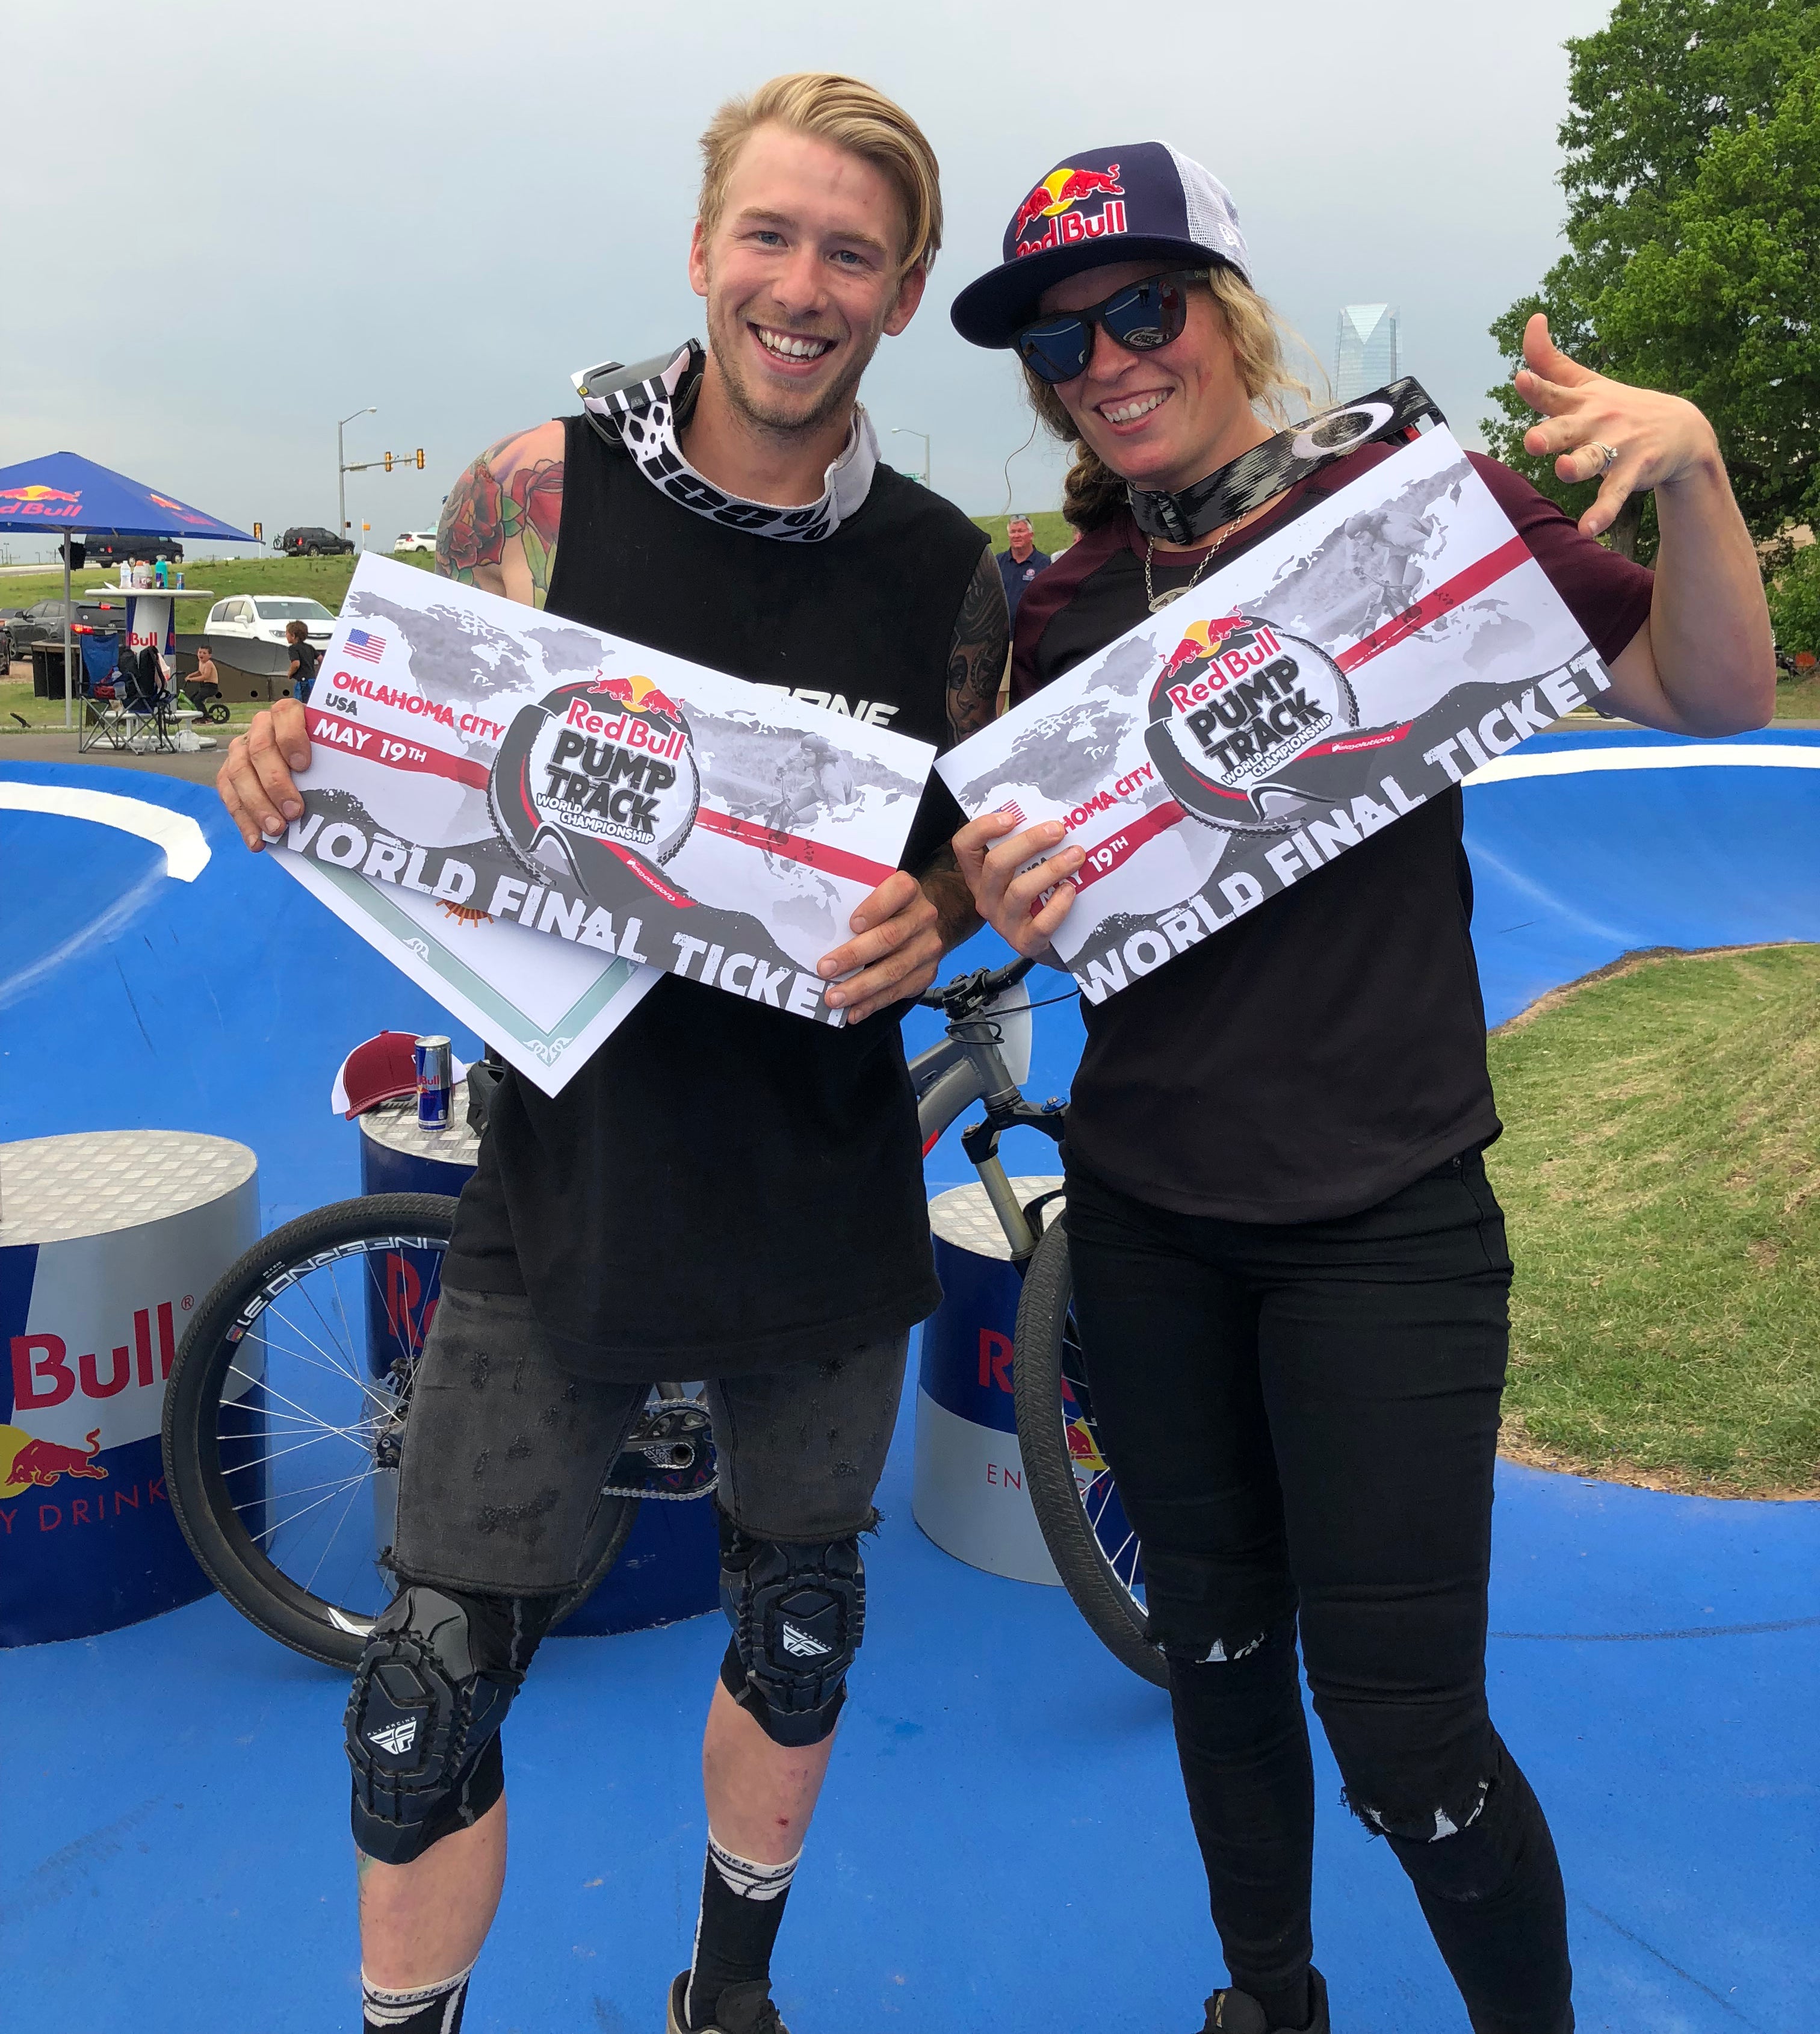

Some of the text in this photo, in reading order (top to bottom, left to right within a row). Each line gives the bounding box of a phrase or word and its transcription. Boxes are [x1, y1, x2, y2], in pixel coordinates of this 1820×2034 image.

[1060, 200, 1127, 244] Bull
[21, 501, 83, 517] Bull
[131, 631, 158, 646] Bull
[1169, 627, 1281, 713] Red Bull
[326, 693, 358, 716] USA
[333, 671, 506, 742] OKLAHOMA CITY
[1186, 654, 1299, 747] PUMP
[314, 718, 427, 763] MAY 19TH
[566, 698, 686, 761] Red Bull
[1202, 687, 1322, 771] TRACK
[1252, 713, 1333, 777] CHAMPIONSHIP
[552, 729, 676, 795] PUMP
[1221, 752, 1264, 786] WORLD
[536, 793, 583, 815] WORLD
[545, 764, 660, 834] TRACK
[1062, 761, 1154, 835] HOMA CITY
[560, 812, 655, 844] CHAMPIONSHIP
[1074, 648, 1612, 1006] WORLD FINAL TICKET
[1088, 836, 1129, 873] 19TH
[488, 875, 648, 964] FINAL
[421, 1075, 439, 1085] Bull
[10, 1301, 176, 1411] Bull
[39, 1476, 170, 1532] DRINK
[987, 1463, 1108, 1500] ENGY
[386, 1716, 415, 1729] RACING
